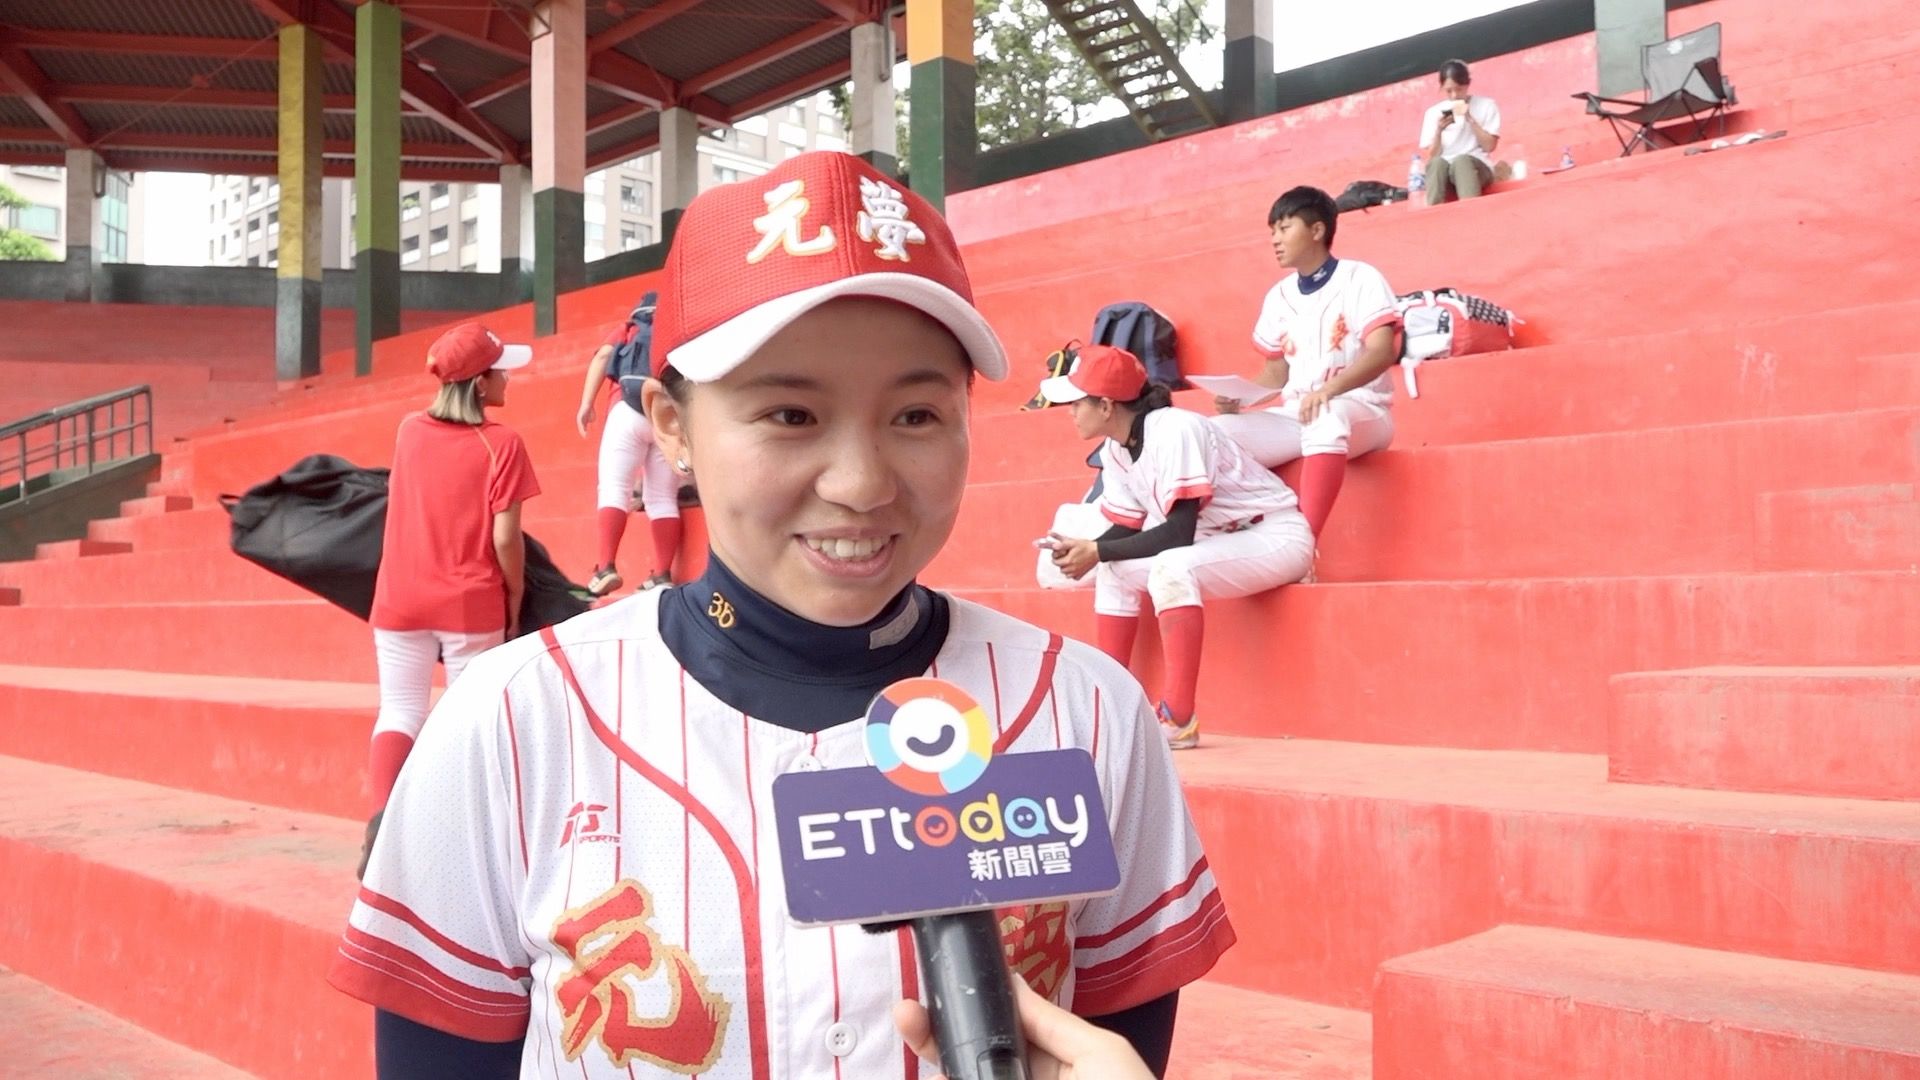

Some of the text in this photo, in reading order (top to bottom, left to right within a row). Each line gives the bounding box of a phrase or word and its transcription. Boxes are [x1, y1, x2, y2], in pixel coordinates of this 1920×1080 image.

[746, 176, 926, 263] 元夢
[798, 792, 1089, 861] ETtoday
[967, 841, 1073, 882] 新聞雲
